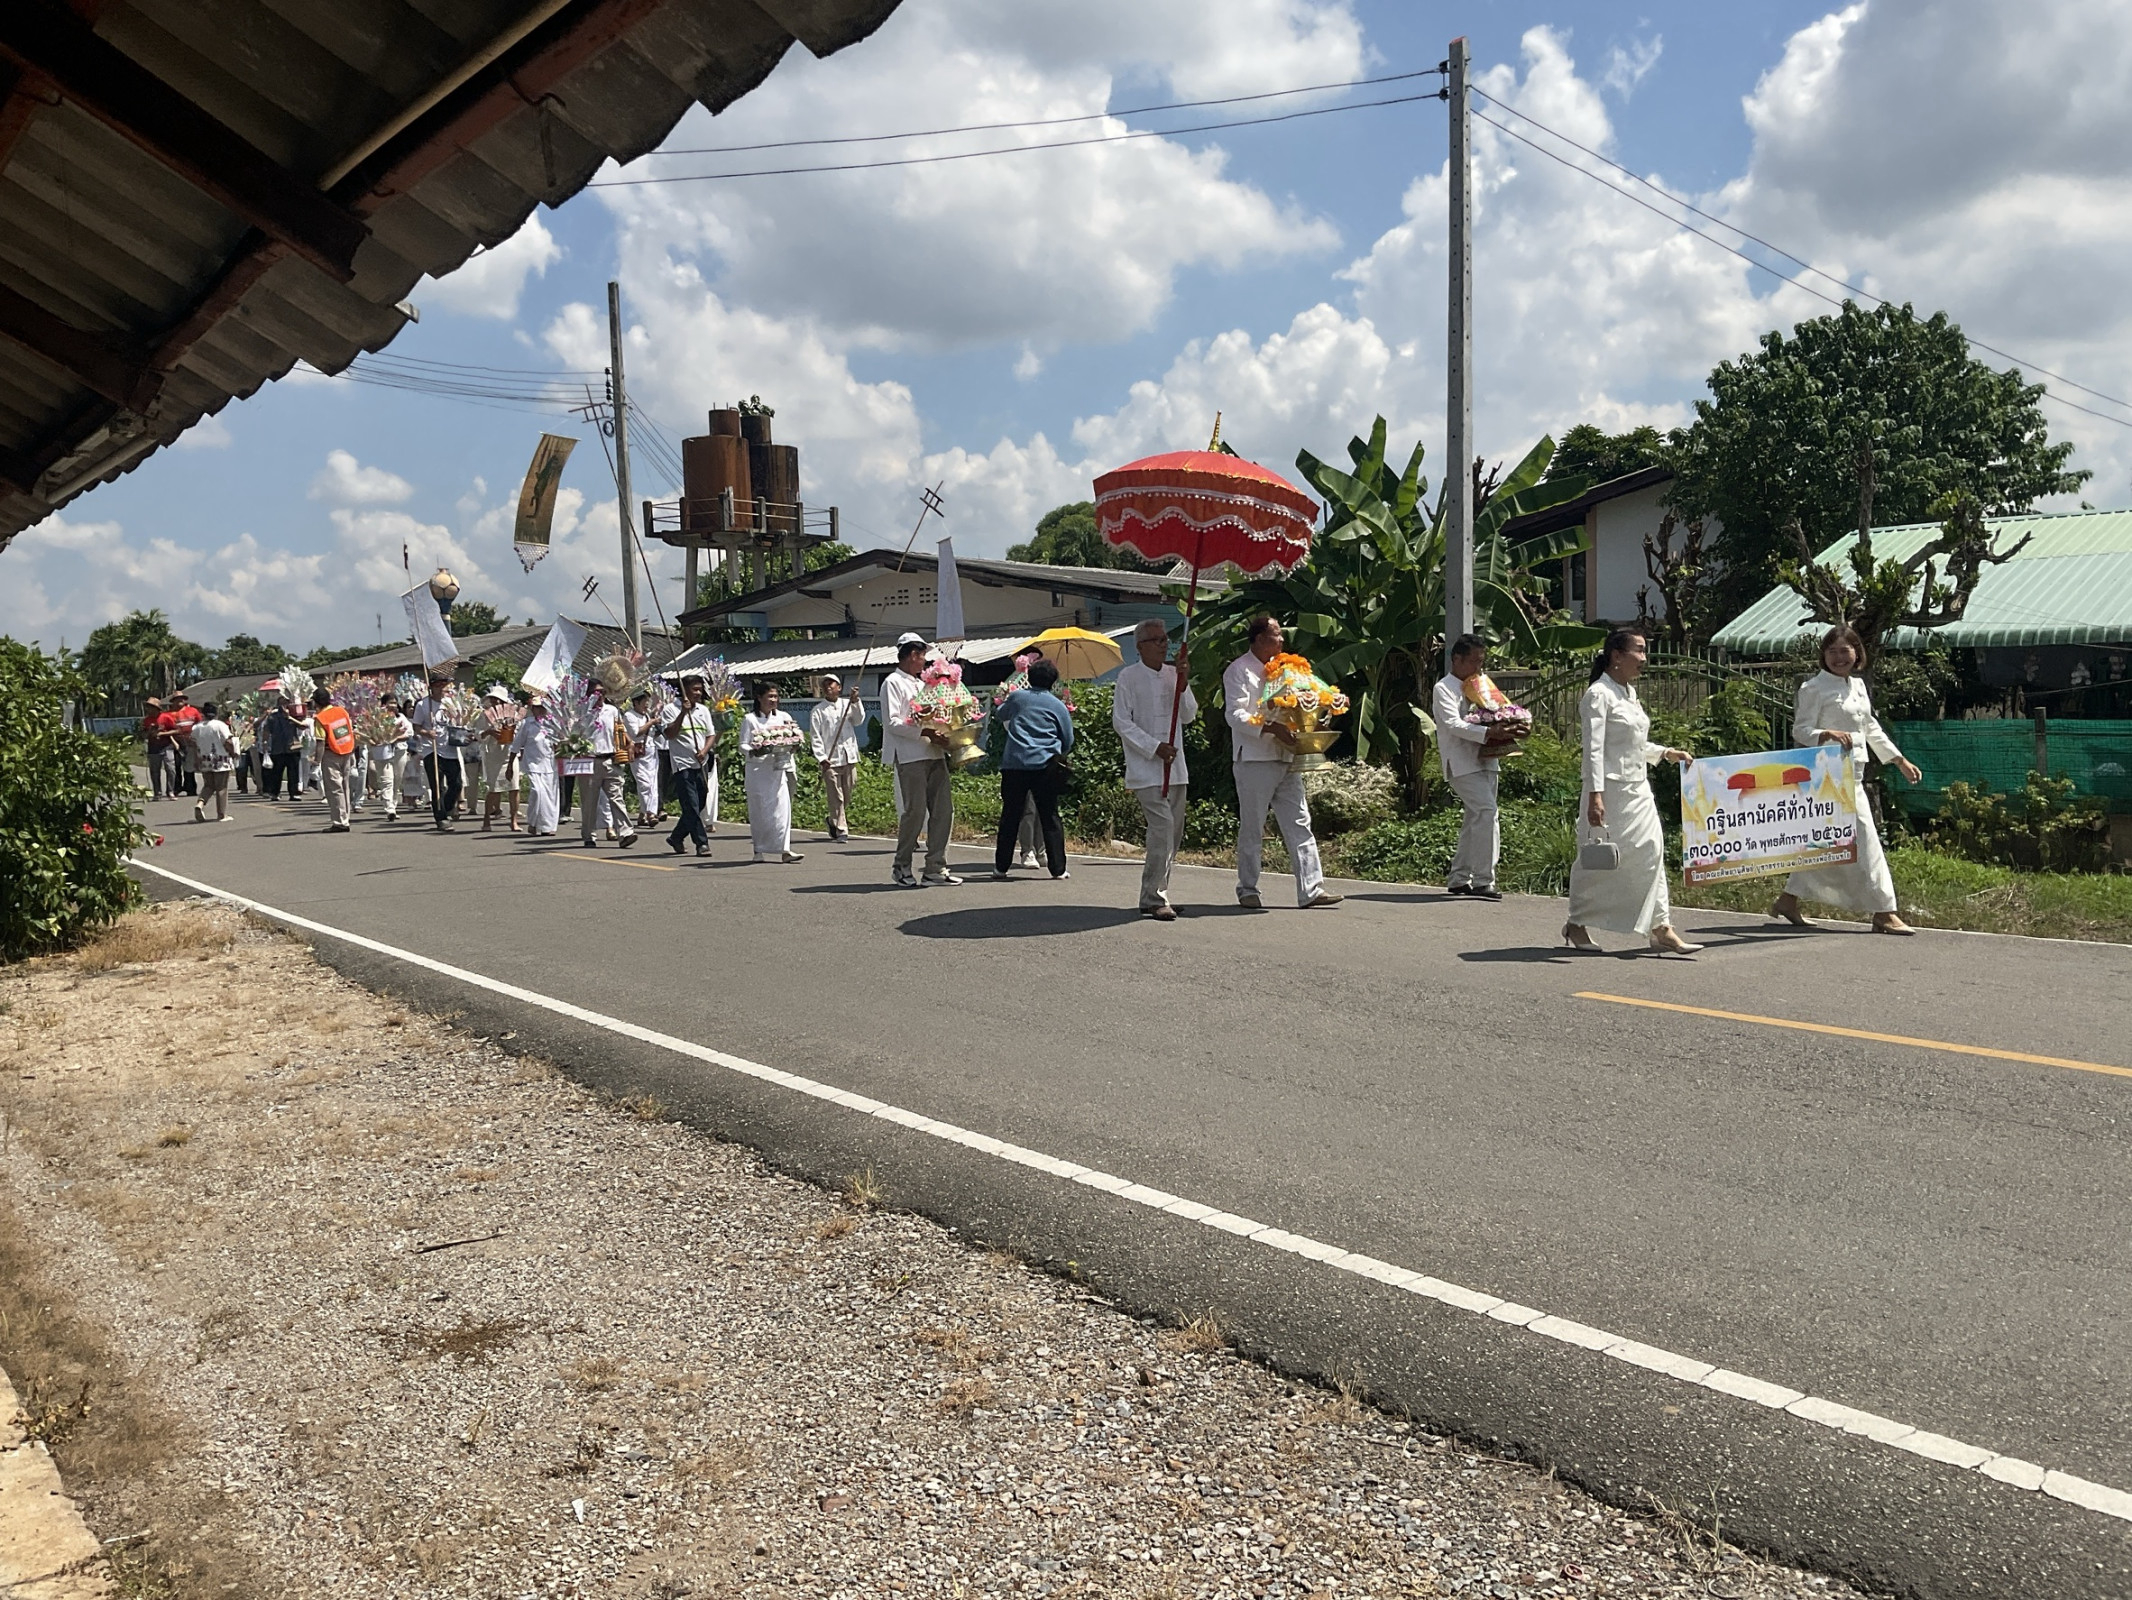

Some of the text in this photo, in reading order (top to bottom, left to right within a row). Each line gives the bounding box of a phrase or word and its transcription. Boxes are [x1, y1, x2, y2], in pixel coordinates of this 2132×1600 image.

[1706, 794, 1834, 835] กฐินสามัคคีทั่วไทย
[1689, 824, 1852, 859] ๓๐,๐๐๐ วัด พุทธศักราช ๒๕๖๘
